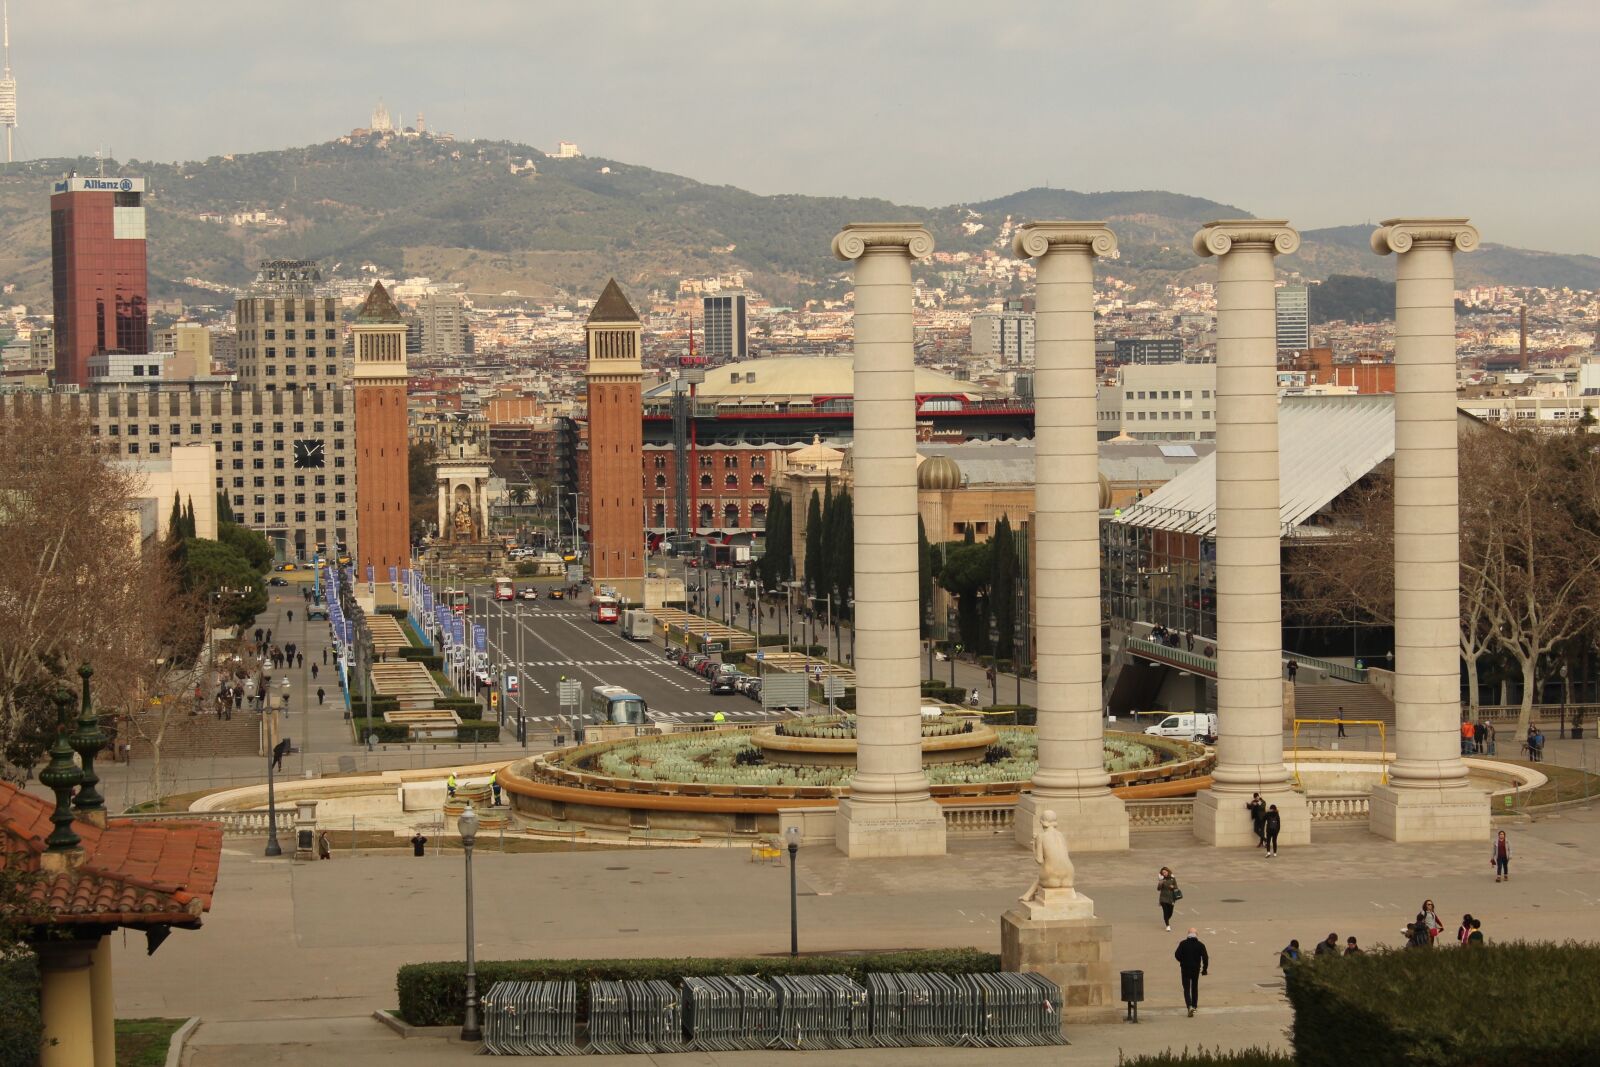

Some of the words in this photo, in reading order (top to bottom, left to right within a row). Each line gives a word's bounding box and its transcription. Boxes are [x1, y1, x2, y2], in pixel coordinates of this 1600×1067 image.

[84, 180, 119, 190] Allianz
[268, 270, 321, 281] PLAZA
[508, 675, 518, 689] P
